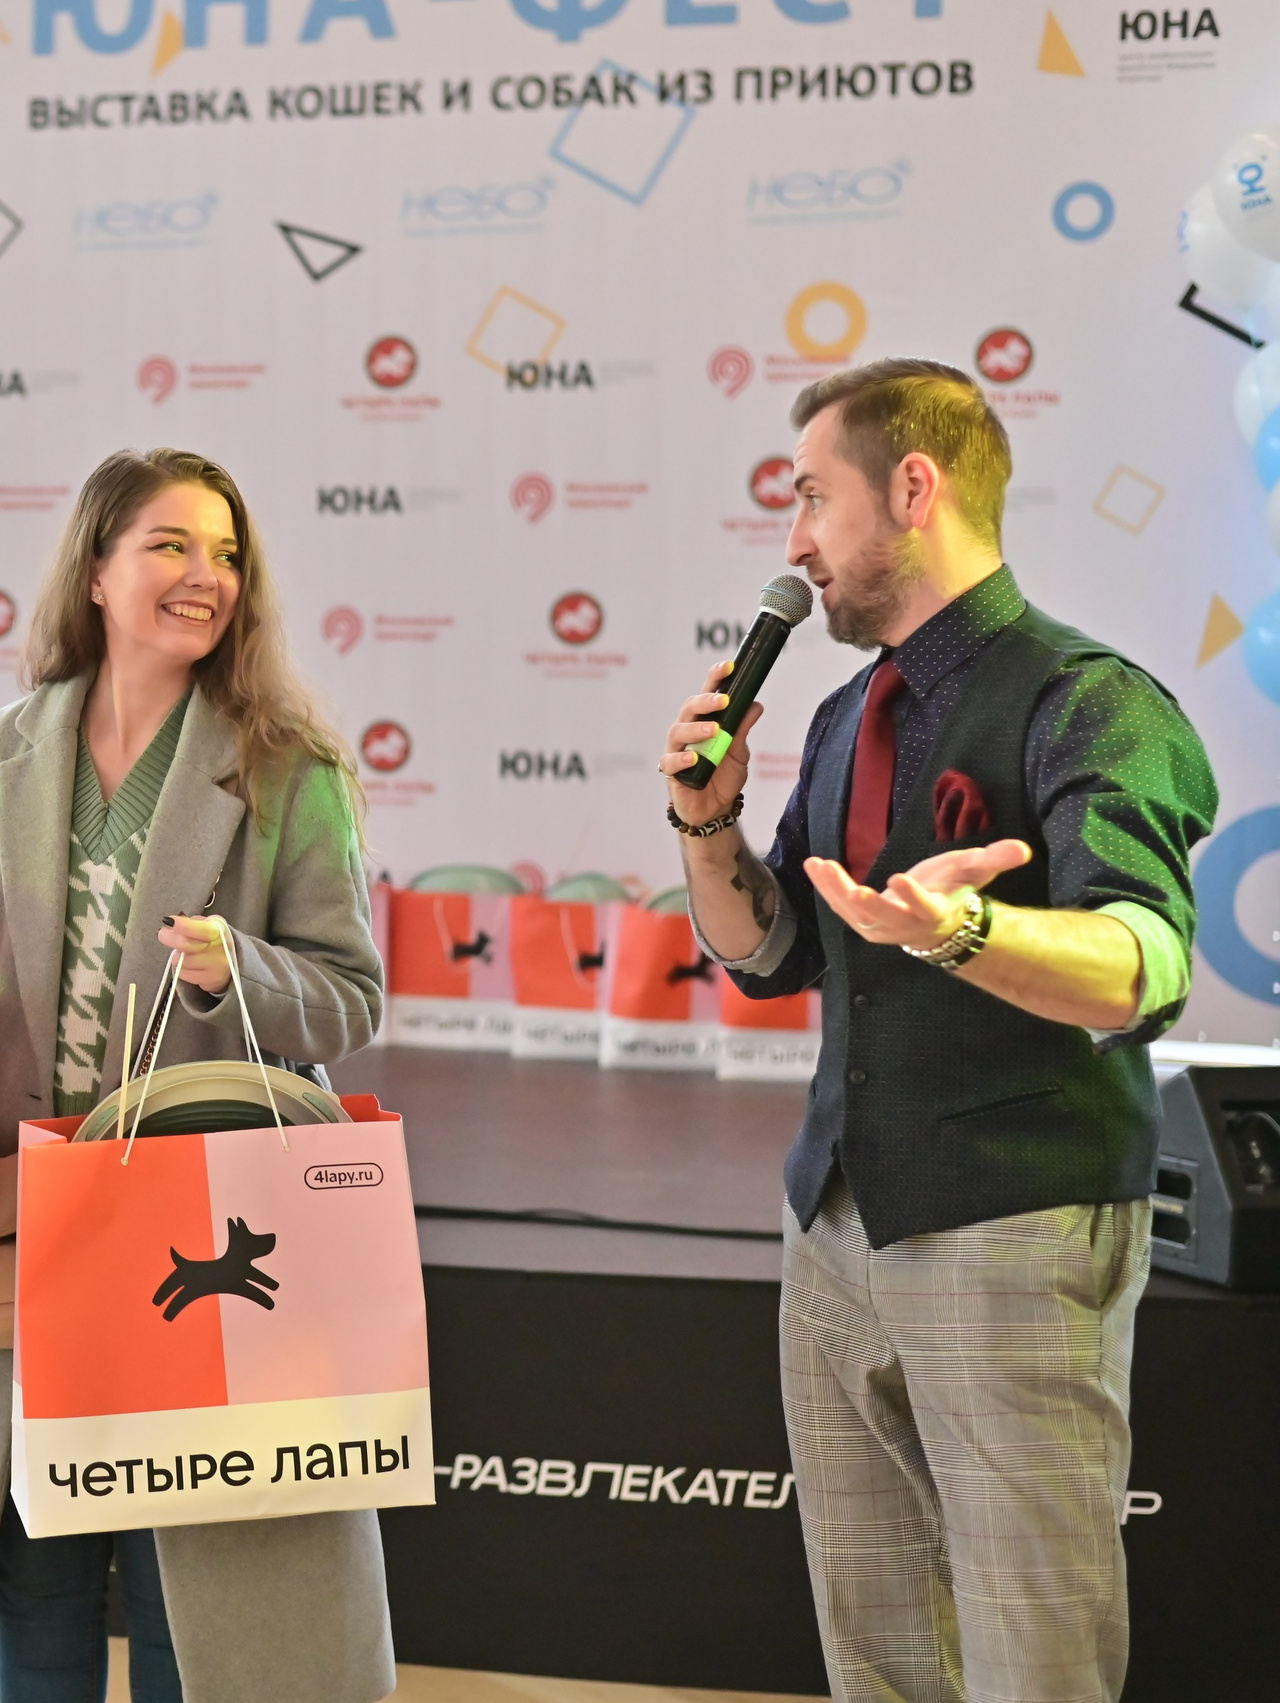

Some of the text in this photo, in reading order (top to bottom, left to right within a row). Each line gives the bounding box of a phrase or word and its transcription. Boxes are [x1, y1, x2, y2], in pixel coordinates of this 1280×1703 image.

[1119, 8, 1220, 41] ЮНА
[29, 59, 976, 131] ВЫСТАВКА КОШЕК И СОБАК ИЗ ПРИЮТОВ
[506, 360, 595, 390] ЮНА
[317, 485, 403, 515] ЮНА
[500, 748, 588, 781] ЮНА
[314, 1167, 373, 1186] 4lapy.ru
[49, 1435, 410, 1498] четыре лапы
